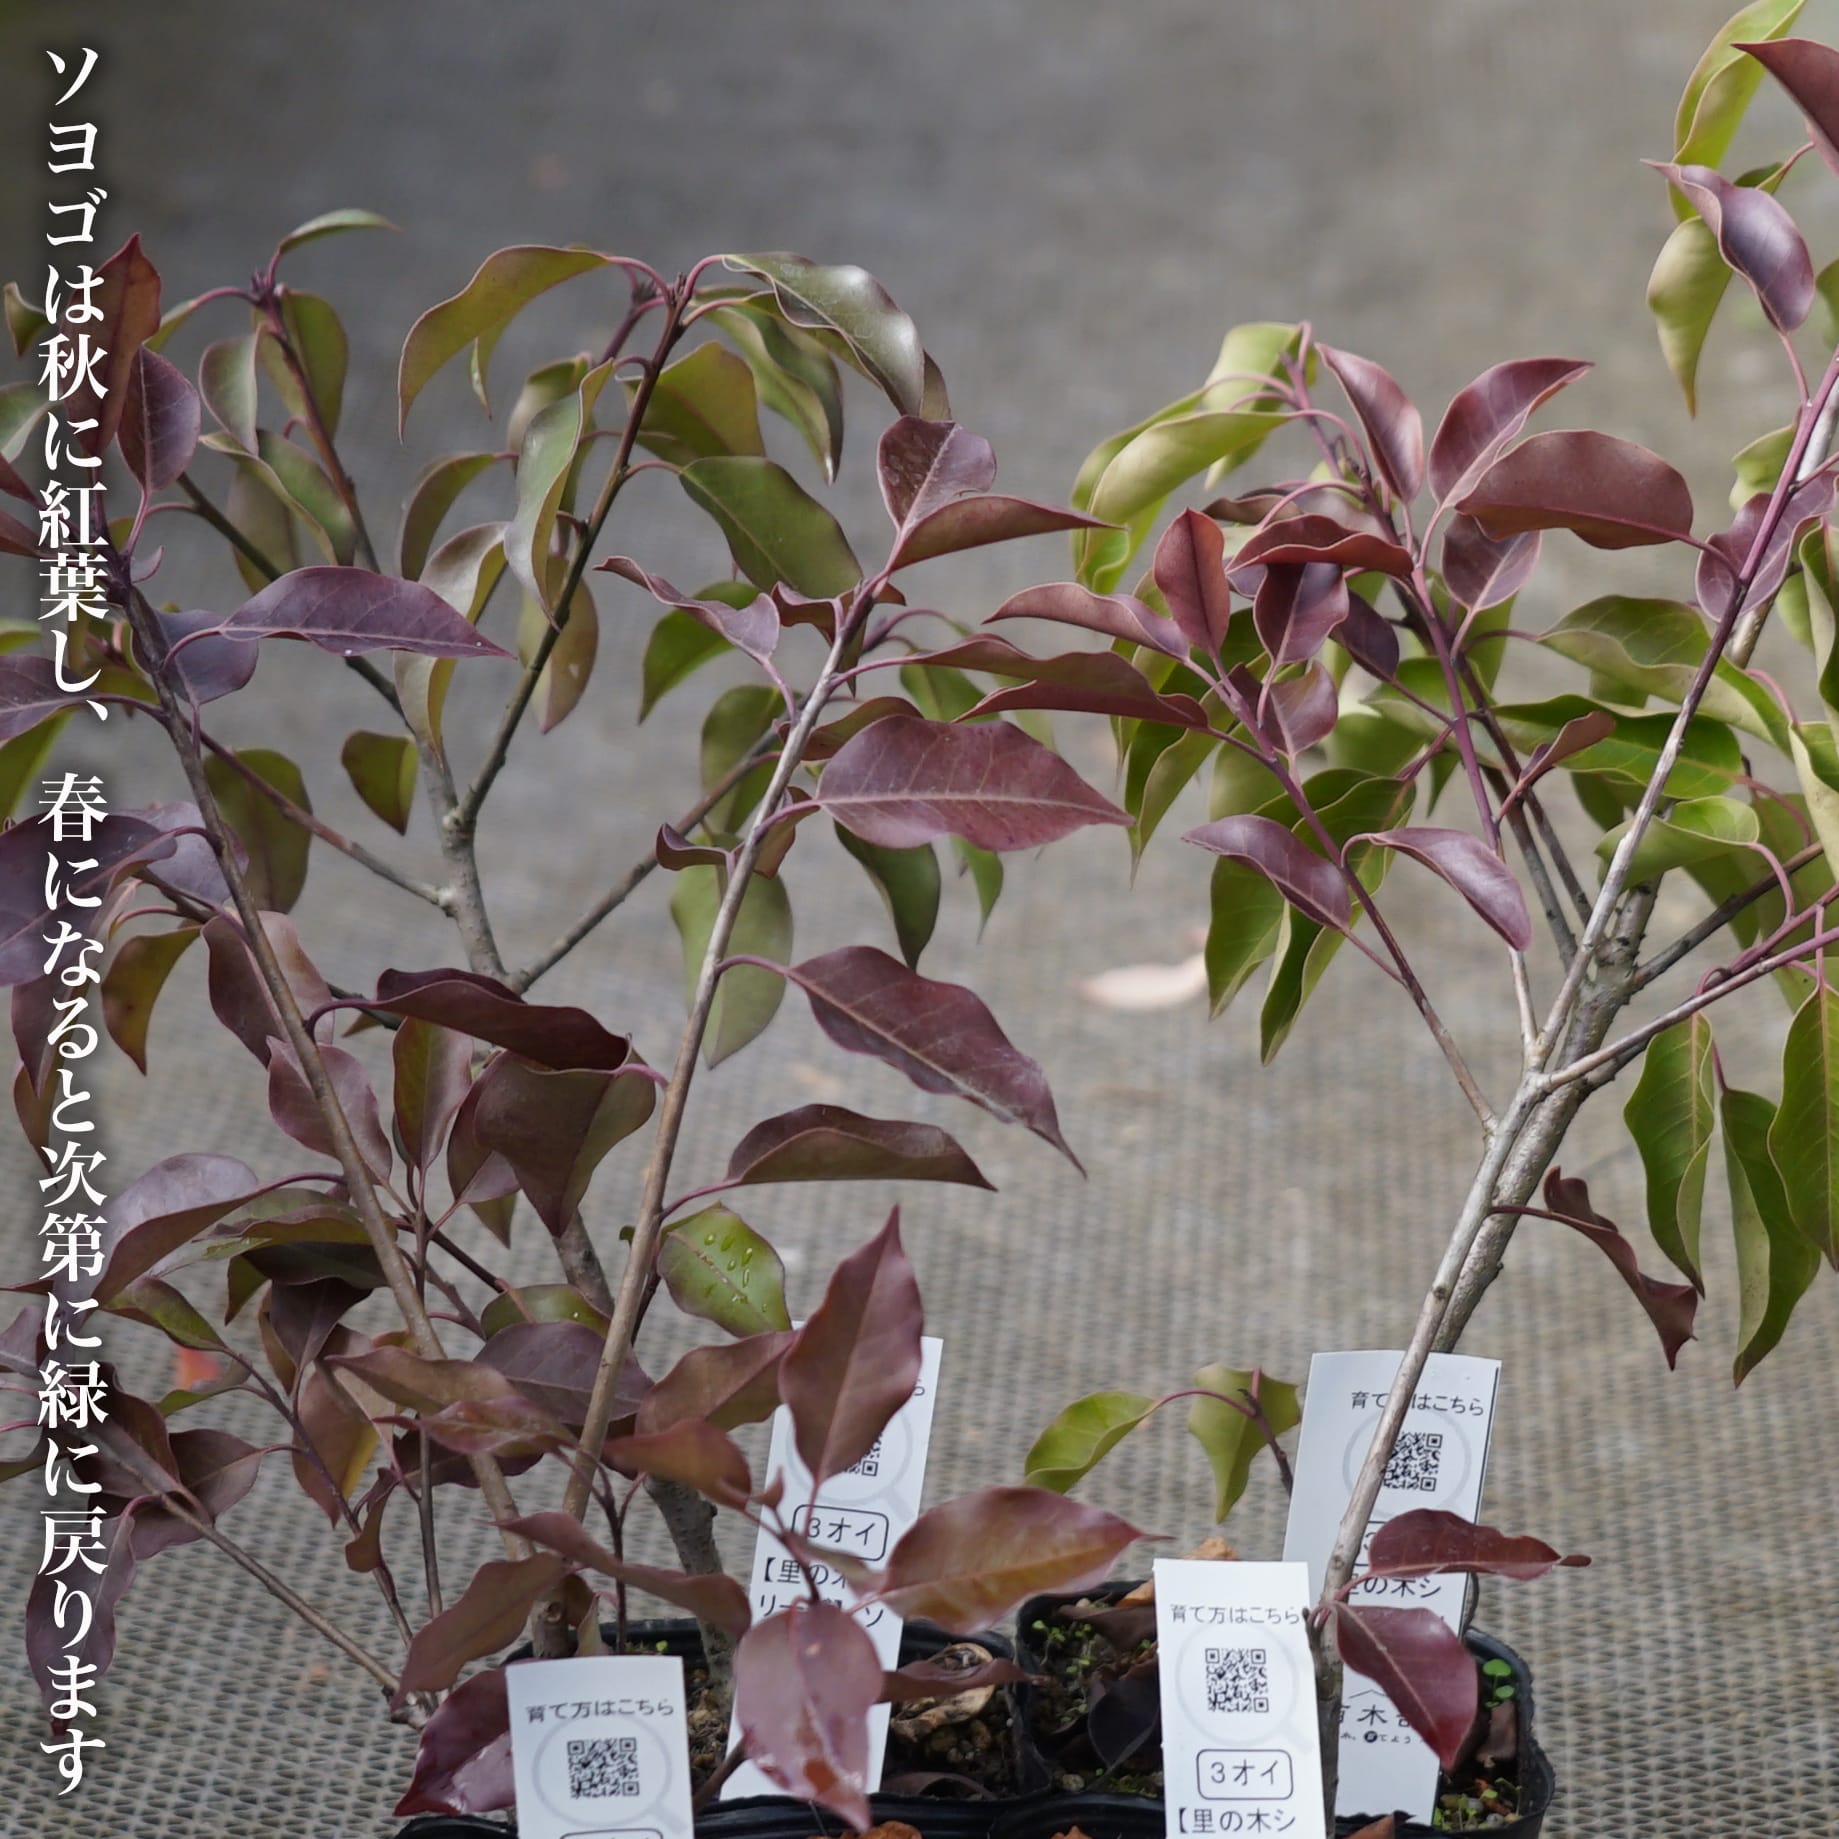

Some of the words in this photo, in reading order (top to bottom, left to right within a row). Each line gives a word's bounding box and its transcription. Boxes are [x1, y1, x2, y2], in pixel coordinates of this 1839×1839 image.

[1351, 1391, 1484, 1416] 育てはこちら
[1348, 1573, 1441, 1598] の木シ
[1170, 1604, 1300, 1625] 育て方はこちら
[526, 1699, 674, 1723] 育て方はこちら
[1210, 1759, 1278, 1786] 3オイ
[1179, 1807, 1296, 1834] 【里の木シ
